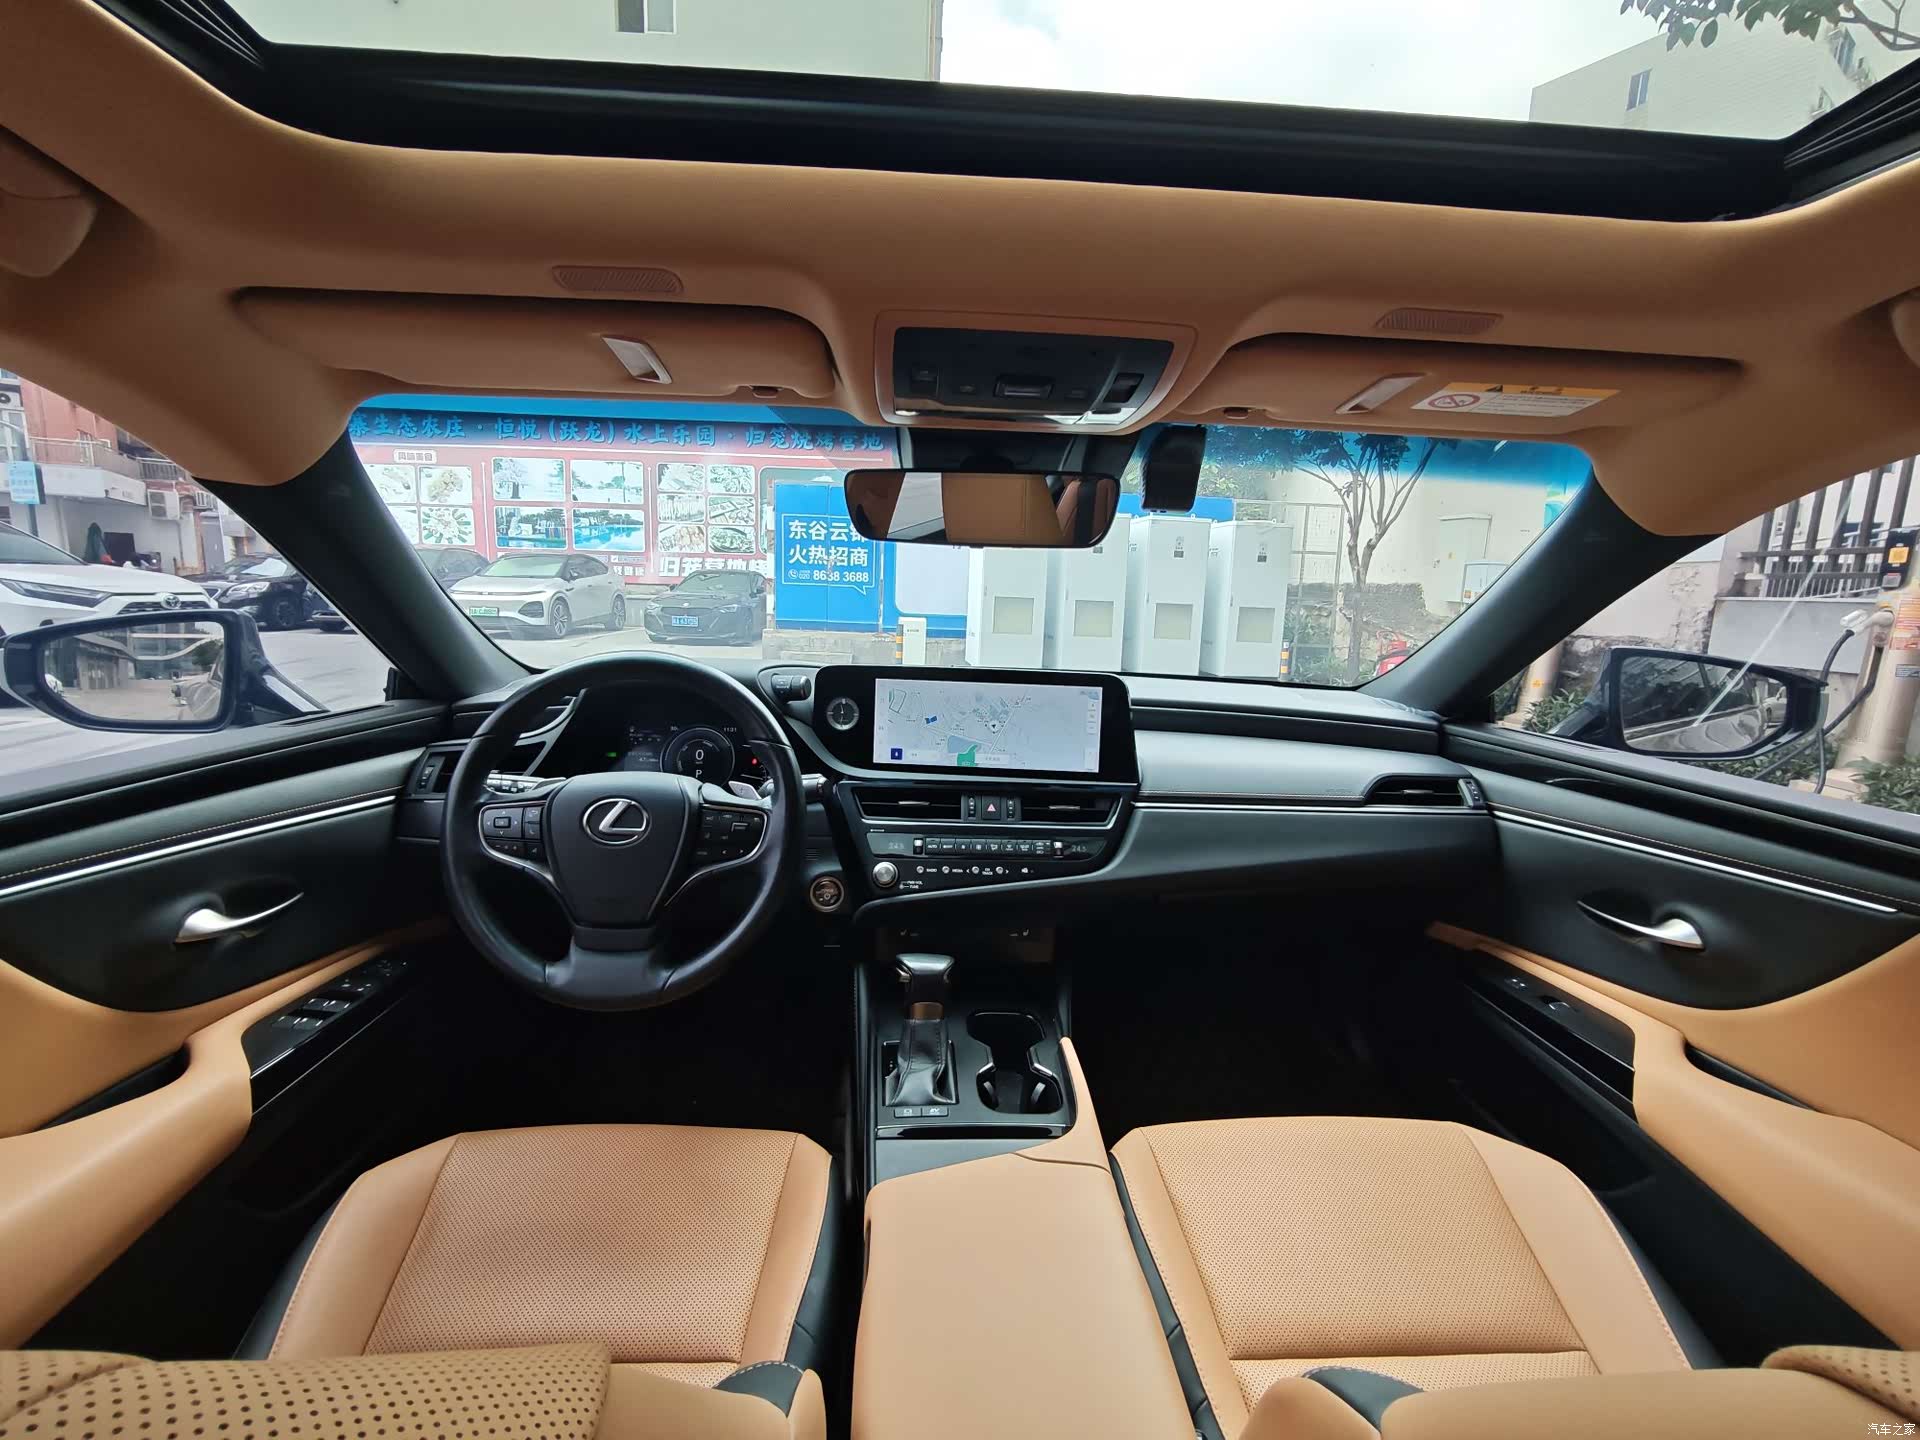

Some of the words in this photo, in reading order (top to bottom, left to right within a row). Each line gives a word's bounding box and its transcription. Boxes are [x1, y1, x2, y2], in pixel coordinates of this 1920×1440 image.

[788, 519, 866, 542] 东谷云
[788, 543, 869, 567] 火热招商
[813, 569, 840, 581] 8638
[842, 571, 869, 583] 3688
[695, 769, 703, 779] P
